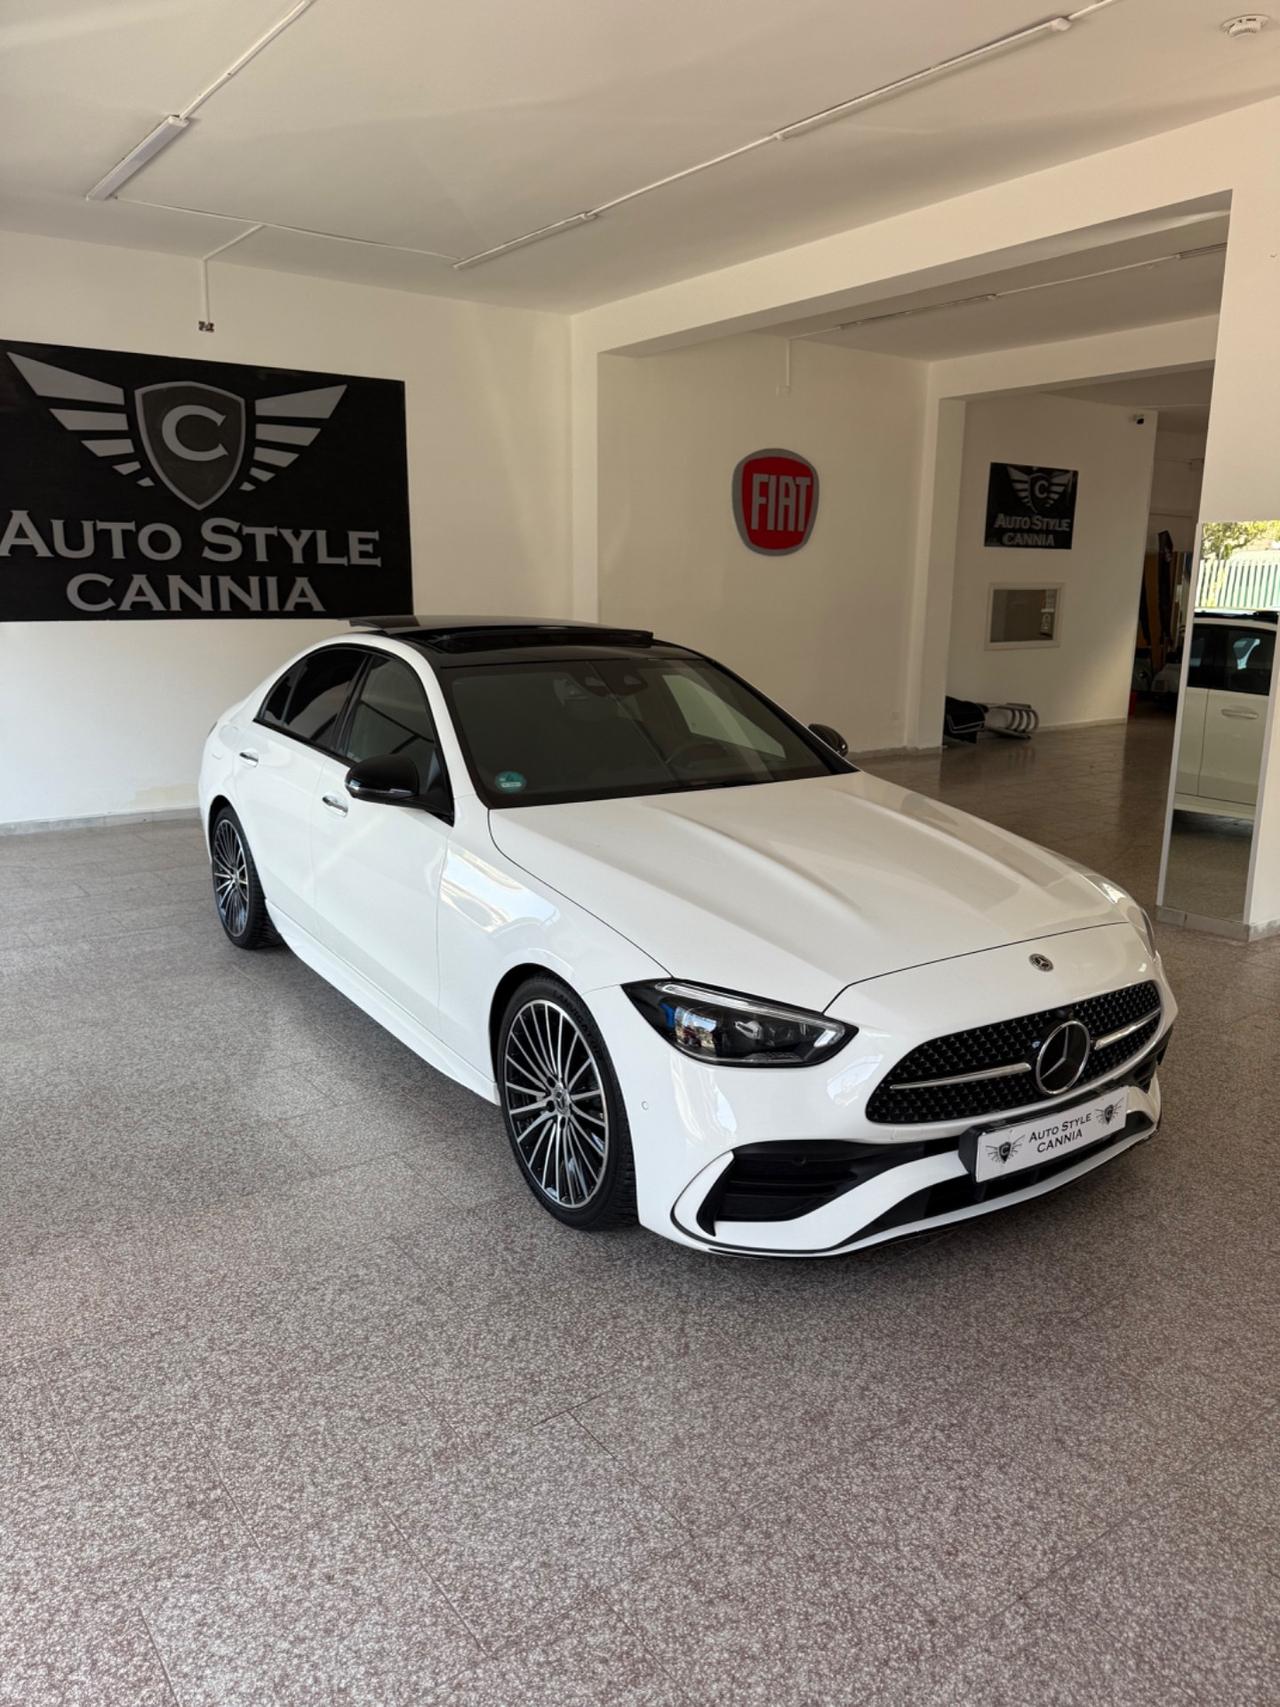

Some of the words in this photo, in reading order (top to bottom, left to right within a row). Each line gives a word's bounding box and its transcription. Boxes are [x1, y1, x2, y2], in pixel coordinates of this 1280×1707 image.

[162, 404, 229, 461] C
[751, 473, 811, 532] FIAT
[1035, 480, 1048, 498] C
[994, 513, 1031, 530] AUTO
[1031, 515, 1071, 532] STYLE
[0, 510, 182, 561] AUTO
[201, 517, 382, 567] STYLE
[1003, 532, 1055, 547] CANNIA
[66, 573, 326, 612] CANNIA
[1029, 1126, 1059, 1143] AUTO
[1061, 1113, 1092, 1132] STYLE
[1037, 1129, 1083, 1153] CANNIA
